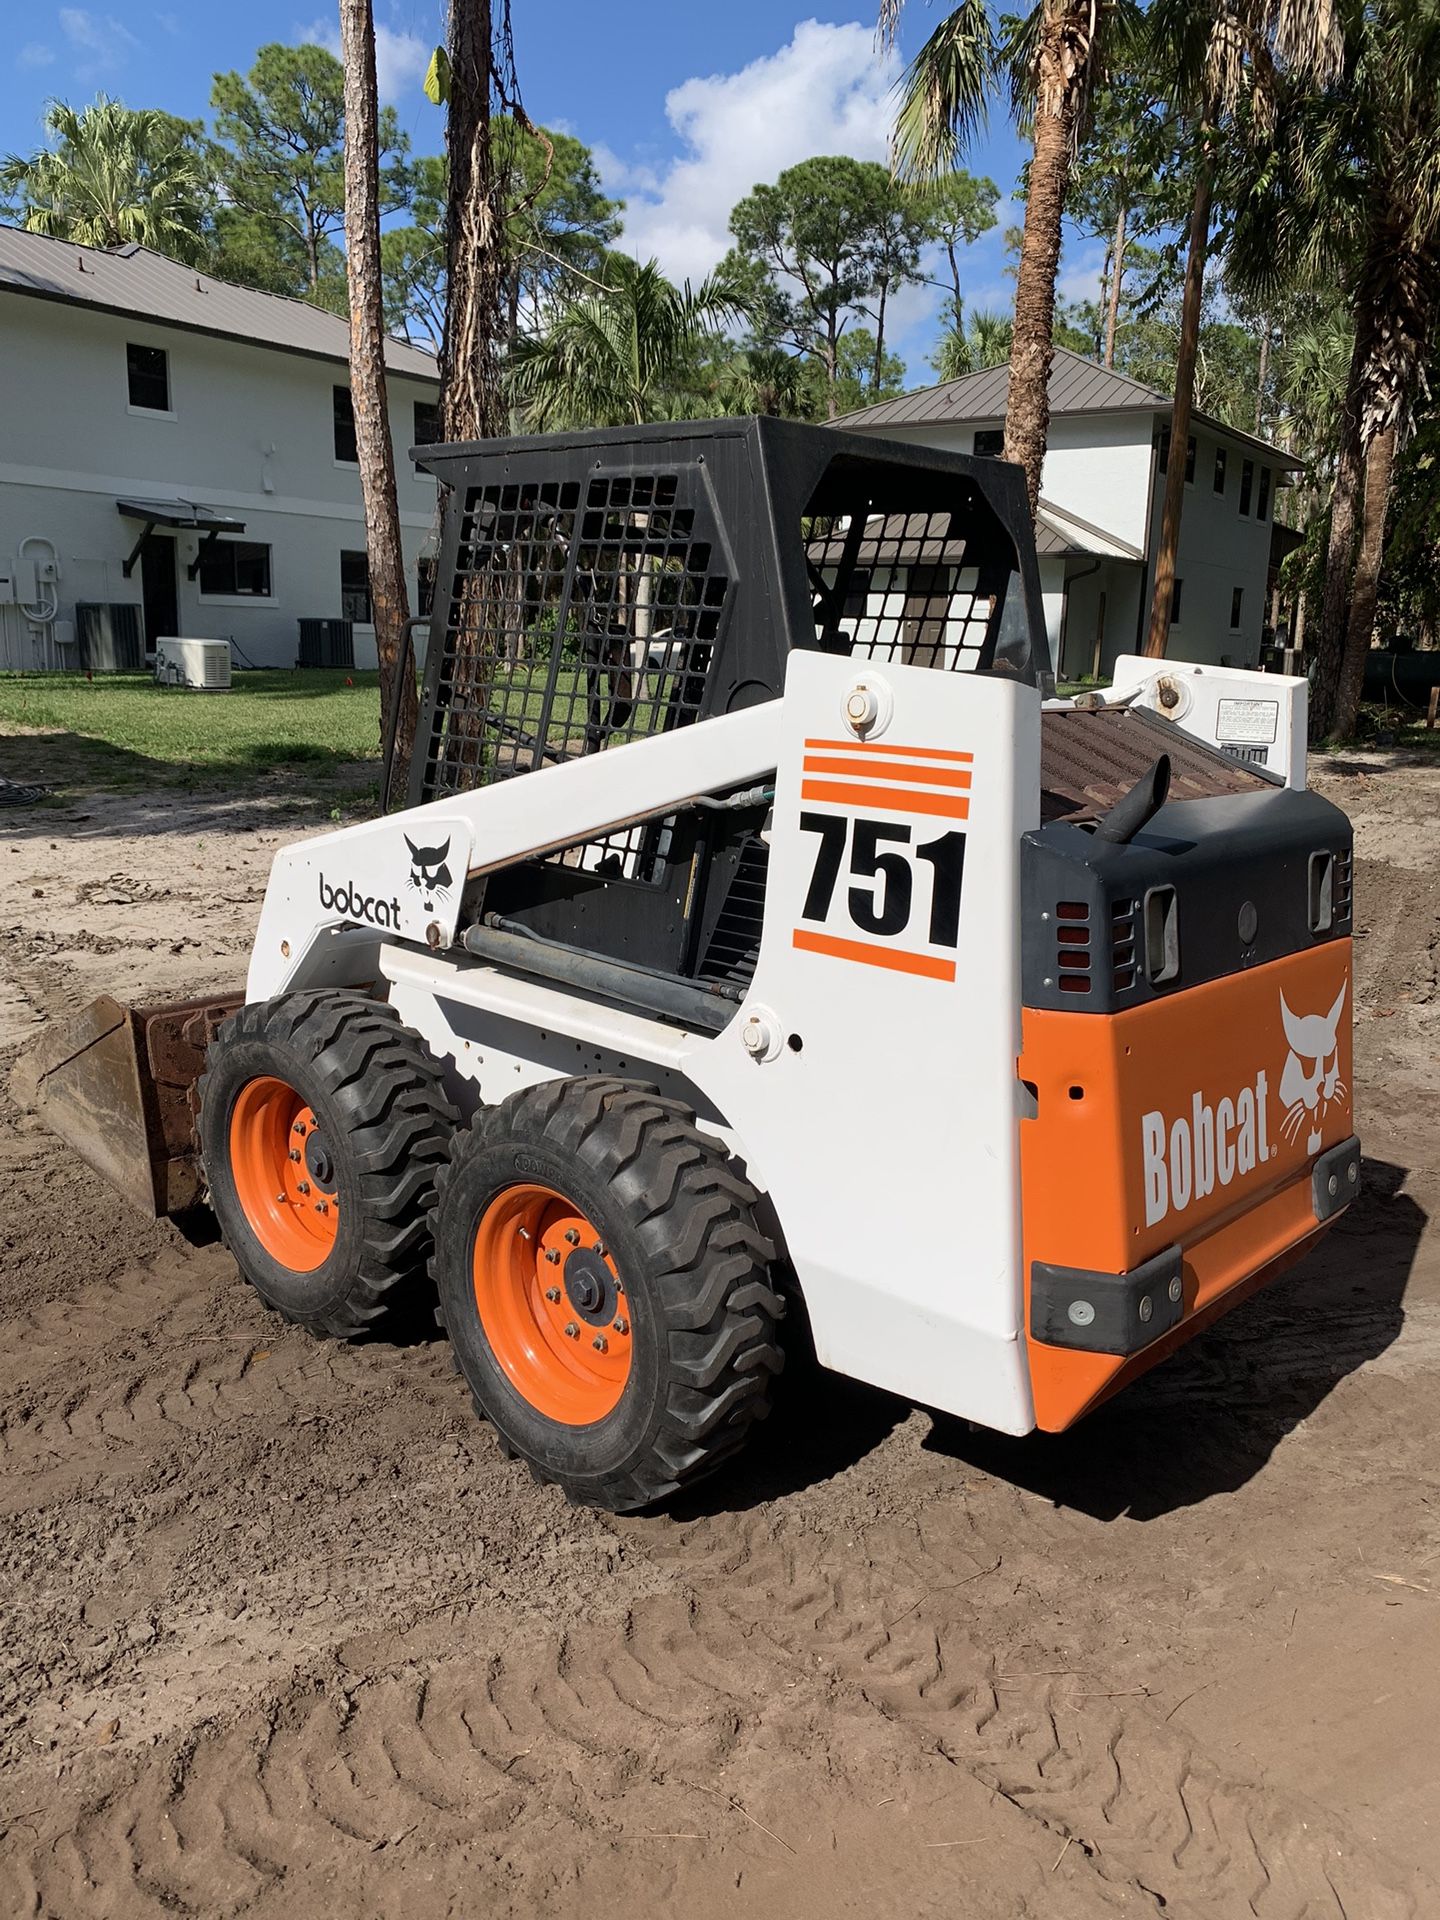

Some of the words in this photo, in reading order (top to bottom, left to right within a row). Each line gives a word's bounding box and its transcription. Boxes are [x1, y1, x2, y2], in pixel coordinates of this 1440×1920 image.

[319, 872, 401, 931] bobcat
[799, 811, 967, 949] 751
[1142, 1069, 1269, 1228] Bobcat
